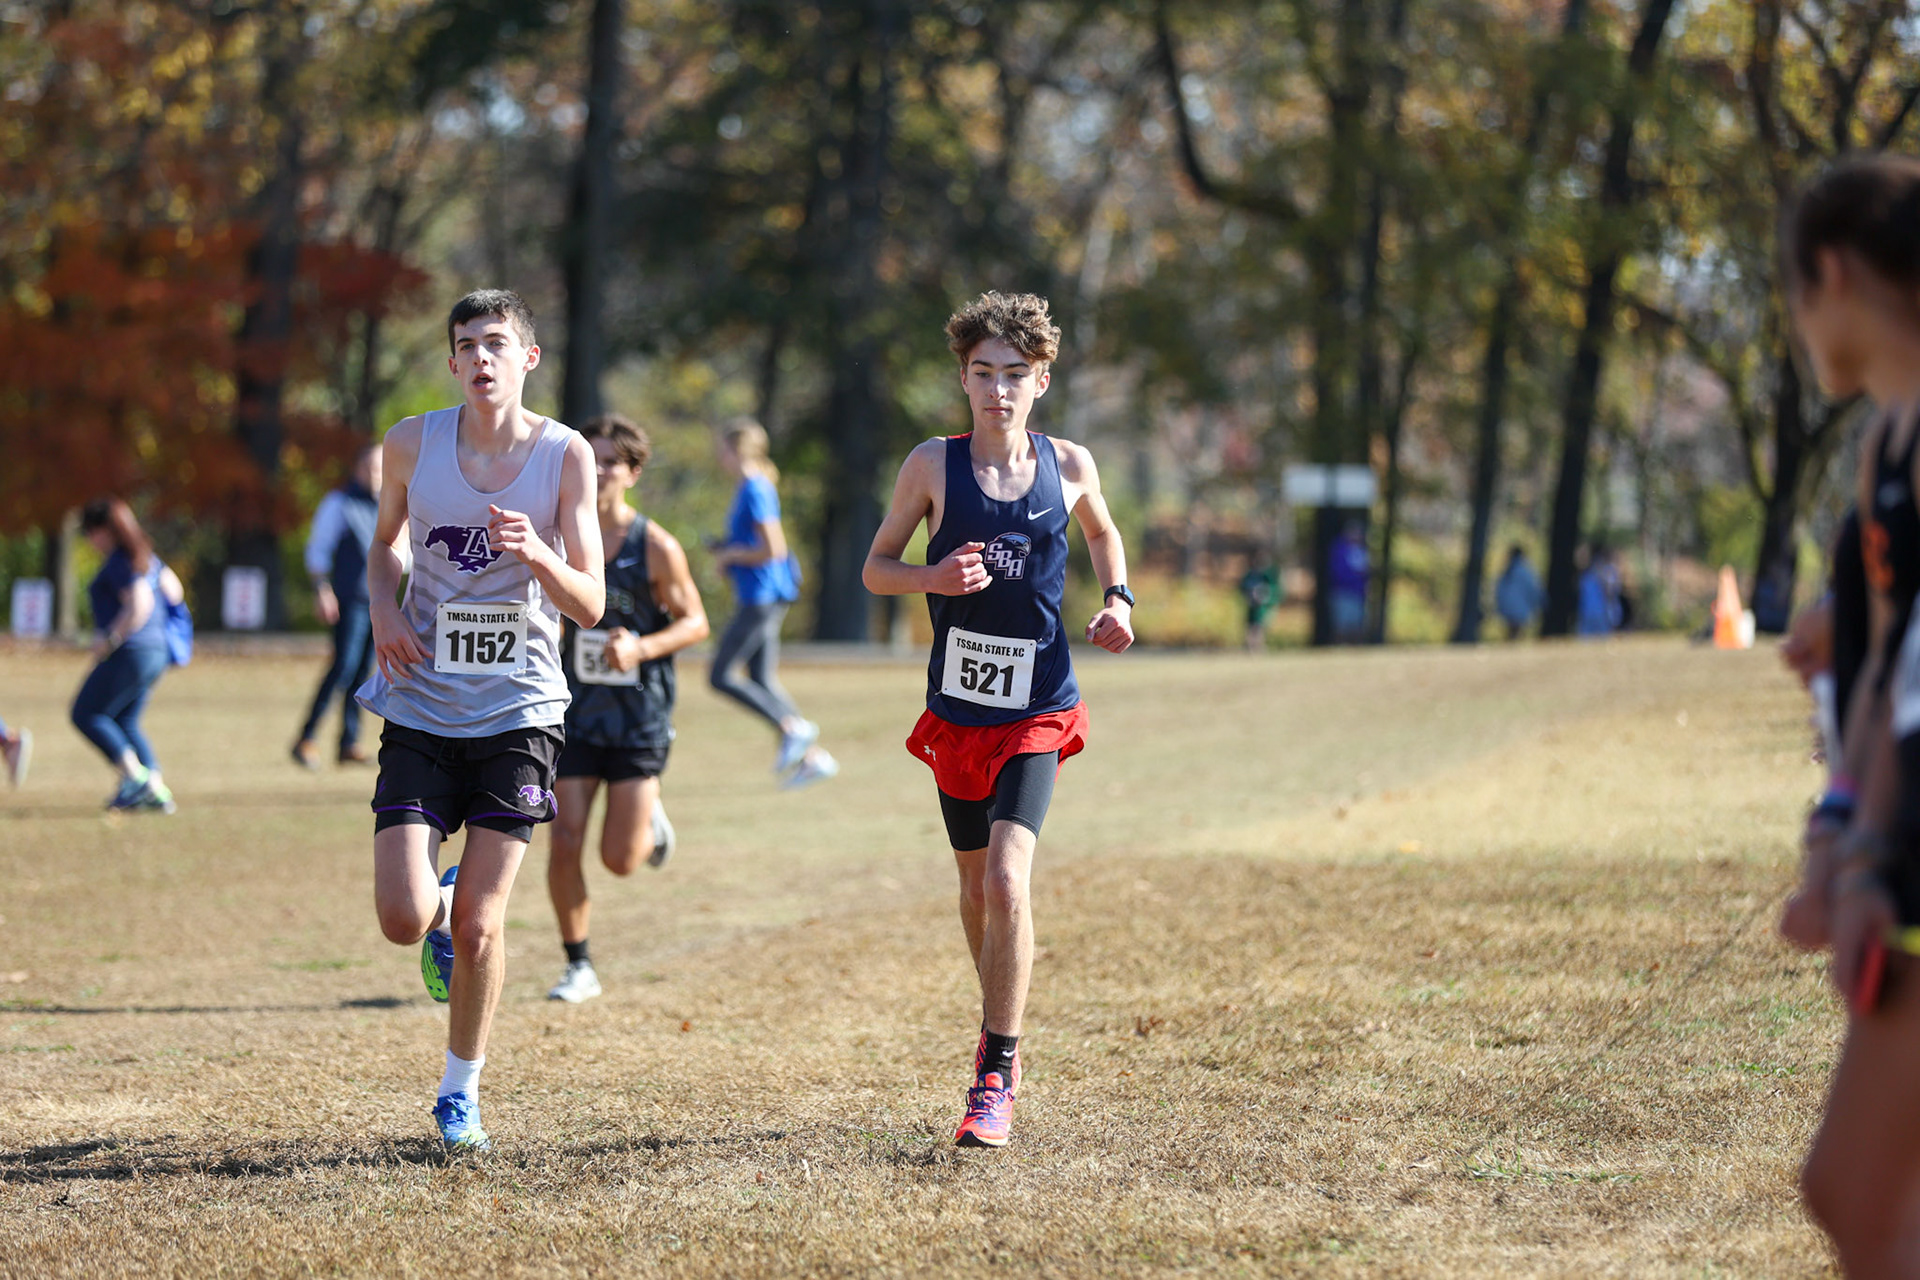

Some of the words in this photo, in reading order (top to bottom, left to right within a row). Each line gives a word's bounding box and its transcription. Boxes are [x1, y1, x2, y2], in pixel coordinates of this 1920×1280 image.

[458, 528, 495, 560] LA
[987, 543, 1024, 577] SBA
[447, 611, 478, 624] TMSAA
[480, 613, 506, 624] STATE
[507, 612, 519, 623] XC
[446, 629, 517, 665] 1152
[956, 637, 983, 653] TSSAA
[984, 643, 1012, 657] STATE
[1012, 647, 1025, 658] XC
[960, 657, 1014, 698] 521
